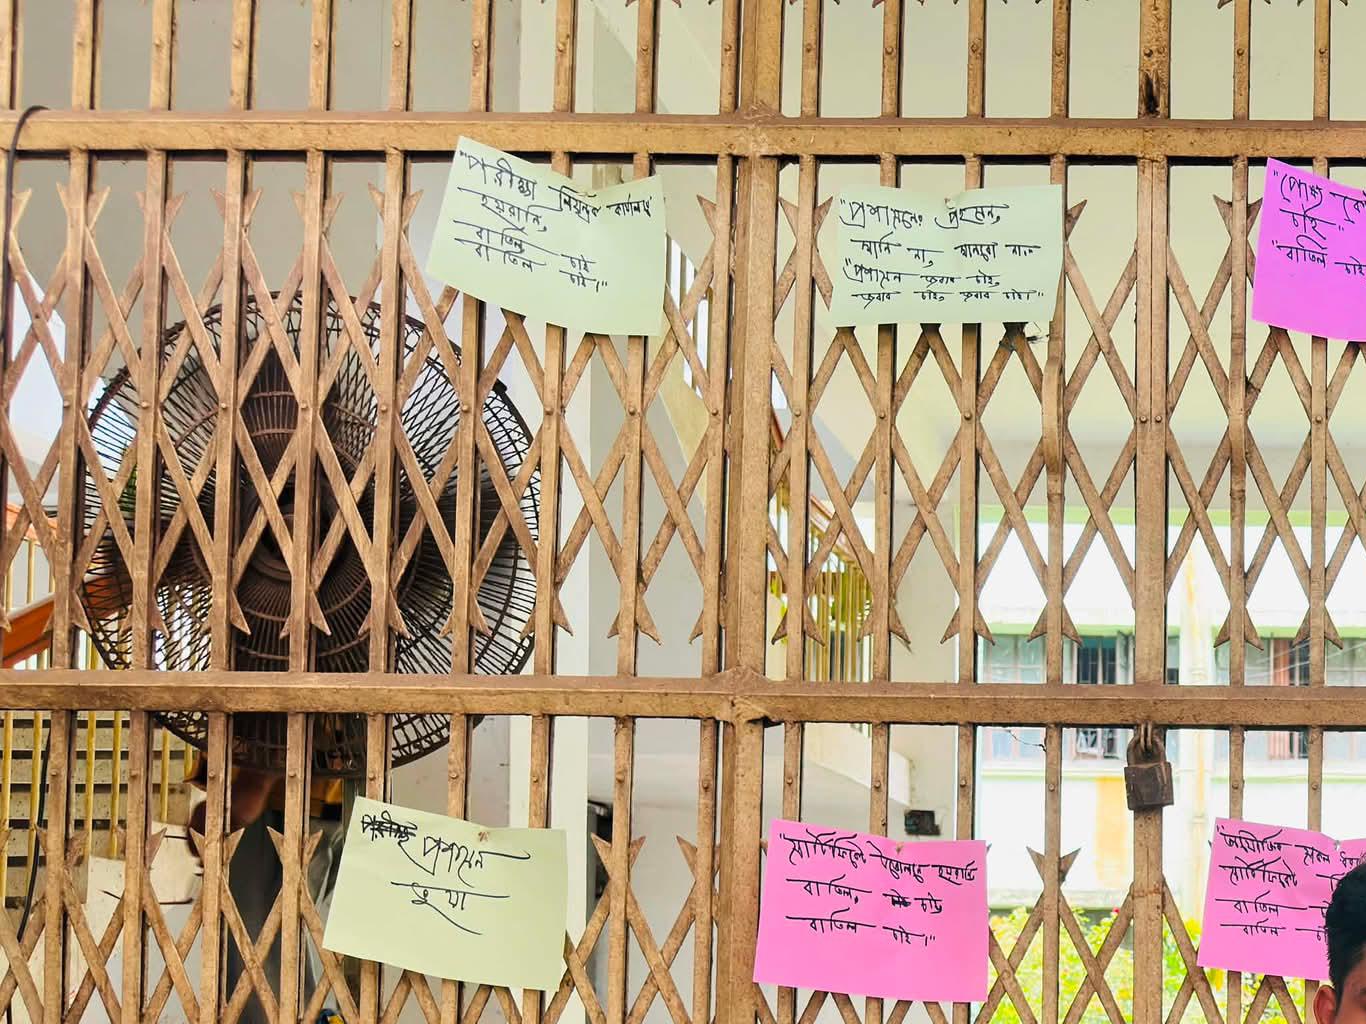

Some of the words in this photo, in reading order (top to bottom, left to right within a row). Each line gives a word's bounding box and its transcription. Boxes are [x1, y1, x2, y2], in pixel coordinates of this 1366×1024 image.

[560, 253, 595, 273] চাই
[1215, 891, 1307, 915] বাতিল
[785, 907, 876, 934] বাতিল
